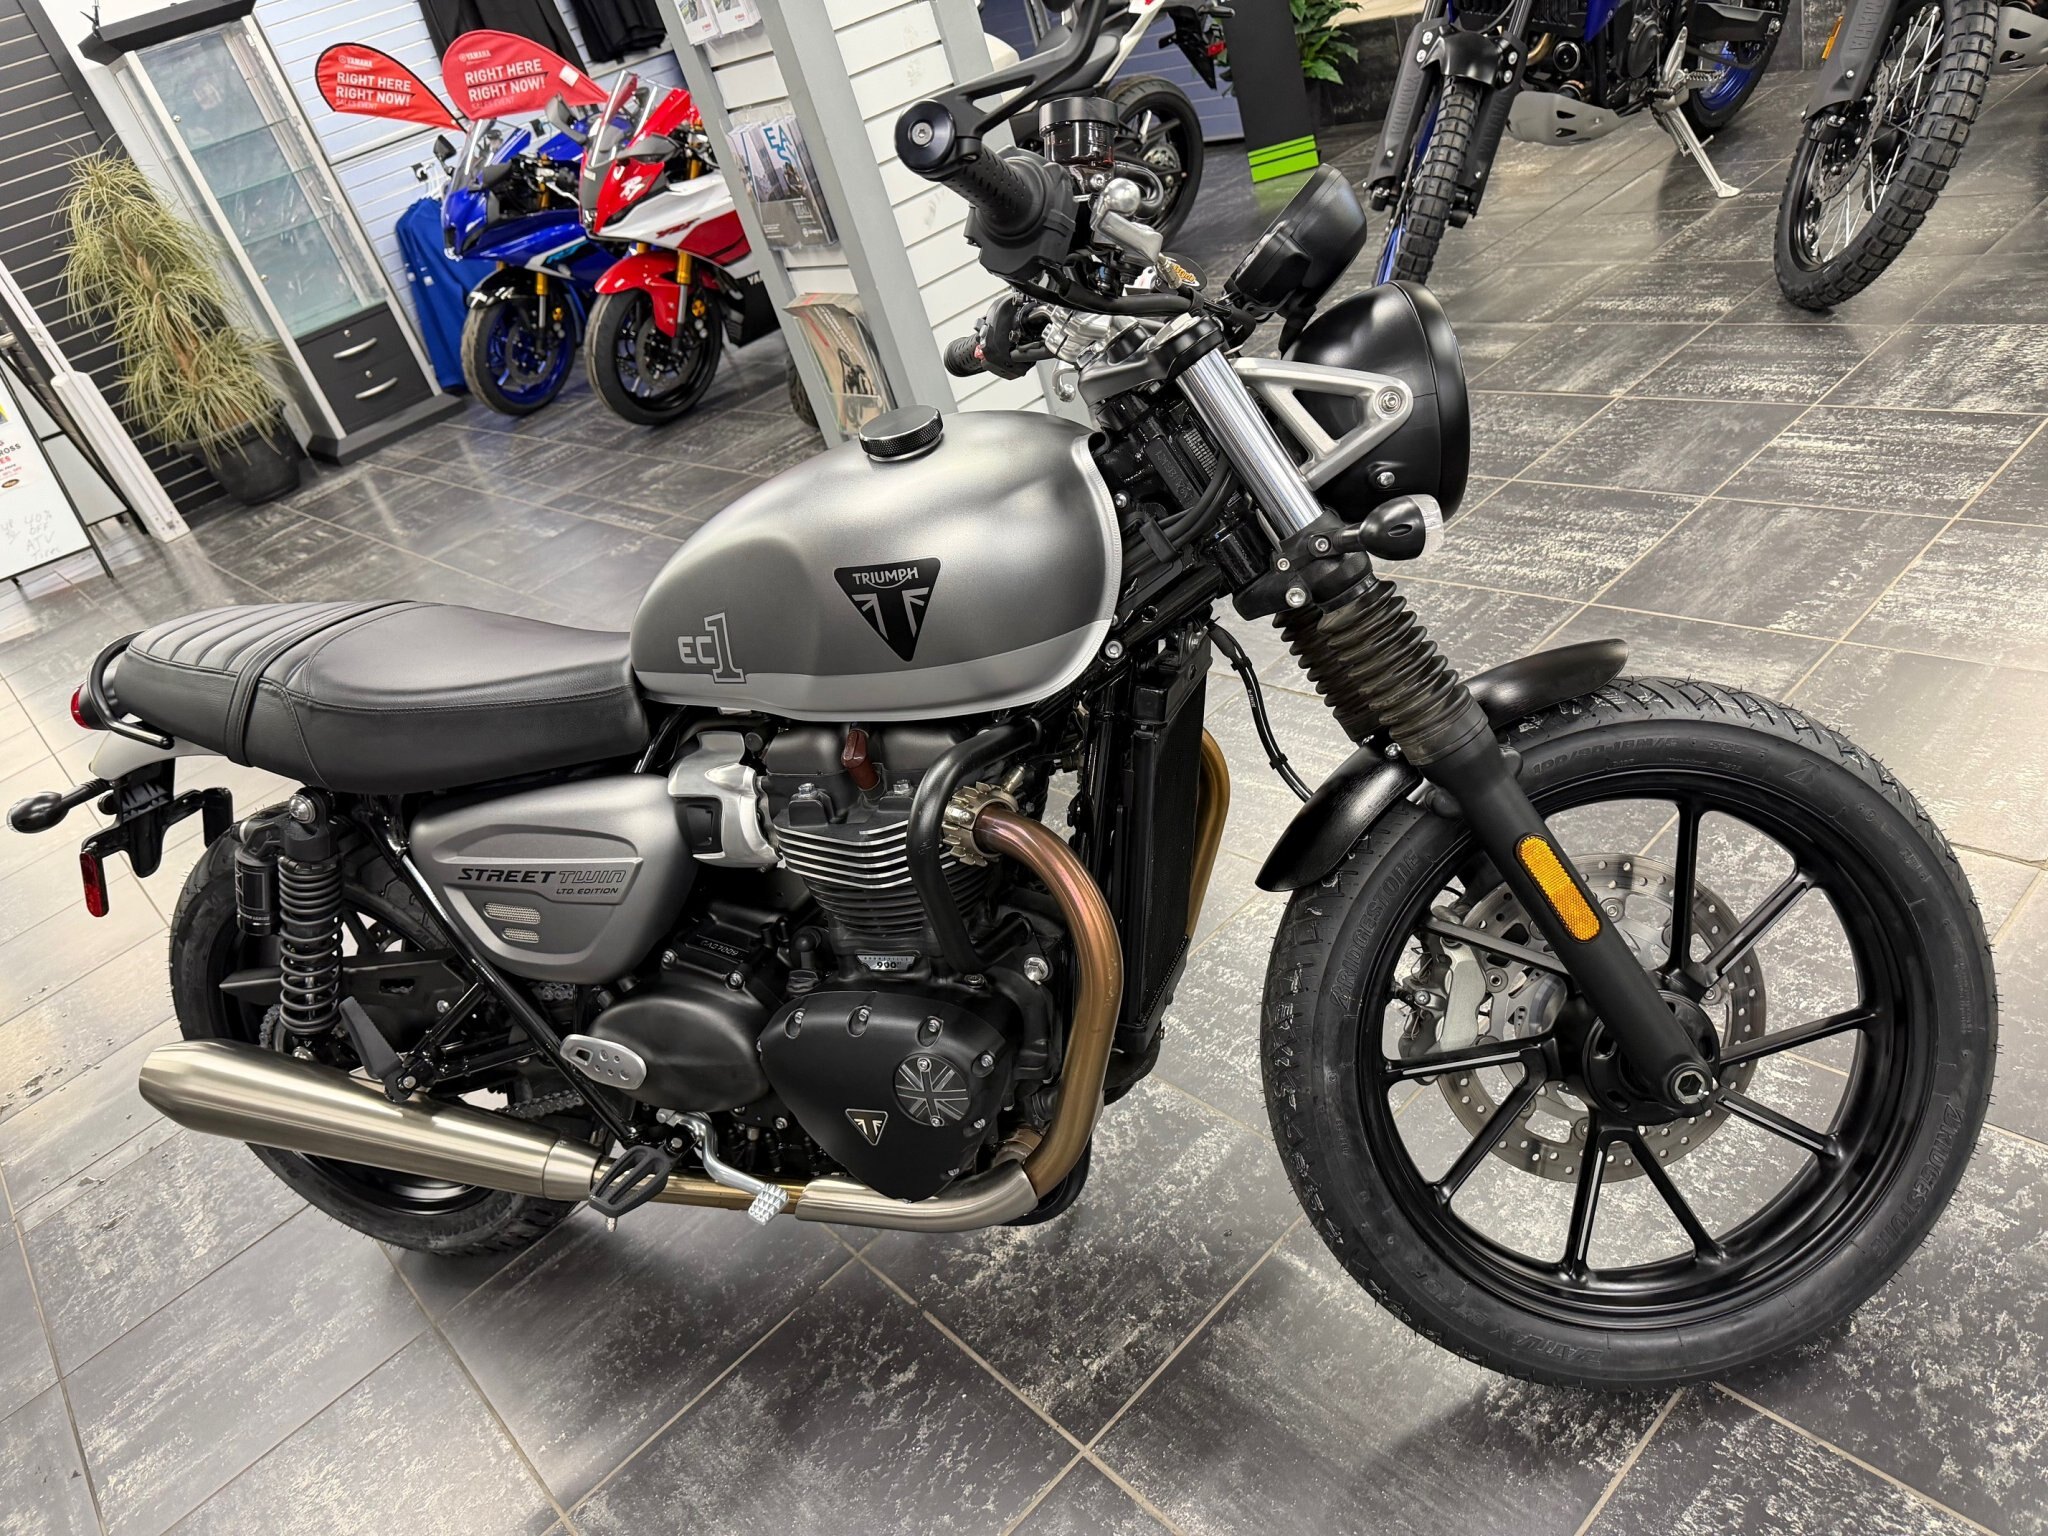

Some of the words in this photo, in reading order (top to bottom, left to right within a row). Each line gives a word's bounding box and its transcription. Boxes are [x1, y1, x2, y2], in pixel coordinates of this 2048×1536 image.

[346, 57, 373, 67] YAMAHA
[466, 49, 491, 60] YAMAHA
[336, 71, 375, 86] RIGHT
[377, 77, 412, 92] HERE
[464, 66, 504, 86] RIGHT
[506, 58, 543, 78] HERE
[335, 85, 374, 101] RIGHT
[375, 93, 411, 107] NOW!
[467, 83, 507, 103] RIGHT
[509, 75, 546, 95] NOW!
[852, 566, 919, 589] TRIUMPH
[677, 611, 747, 684] EC1
[457, 867, 556, 884] STREET
[558, 869, 627, 884] TWIN
[577, 887, 619, 895] EDITION
[1330, 850, 1423, 1010] BRIDGESTONE
[1868, 1103, 1968, 1262] BRIDGESTONE
